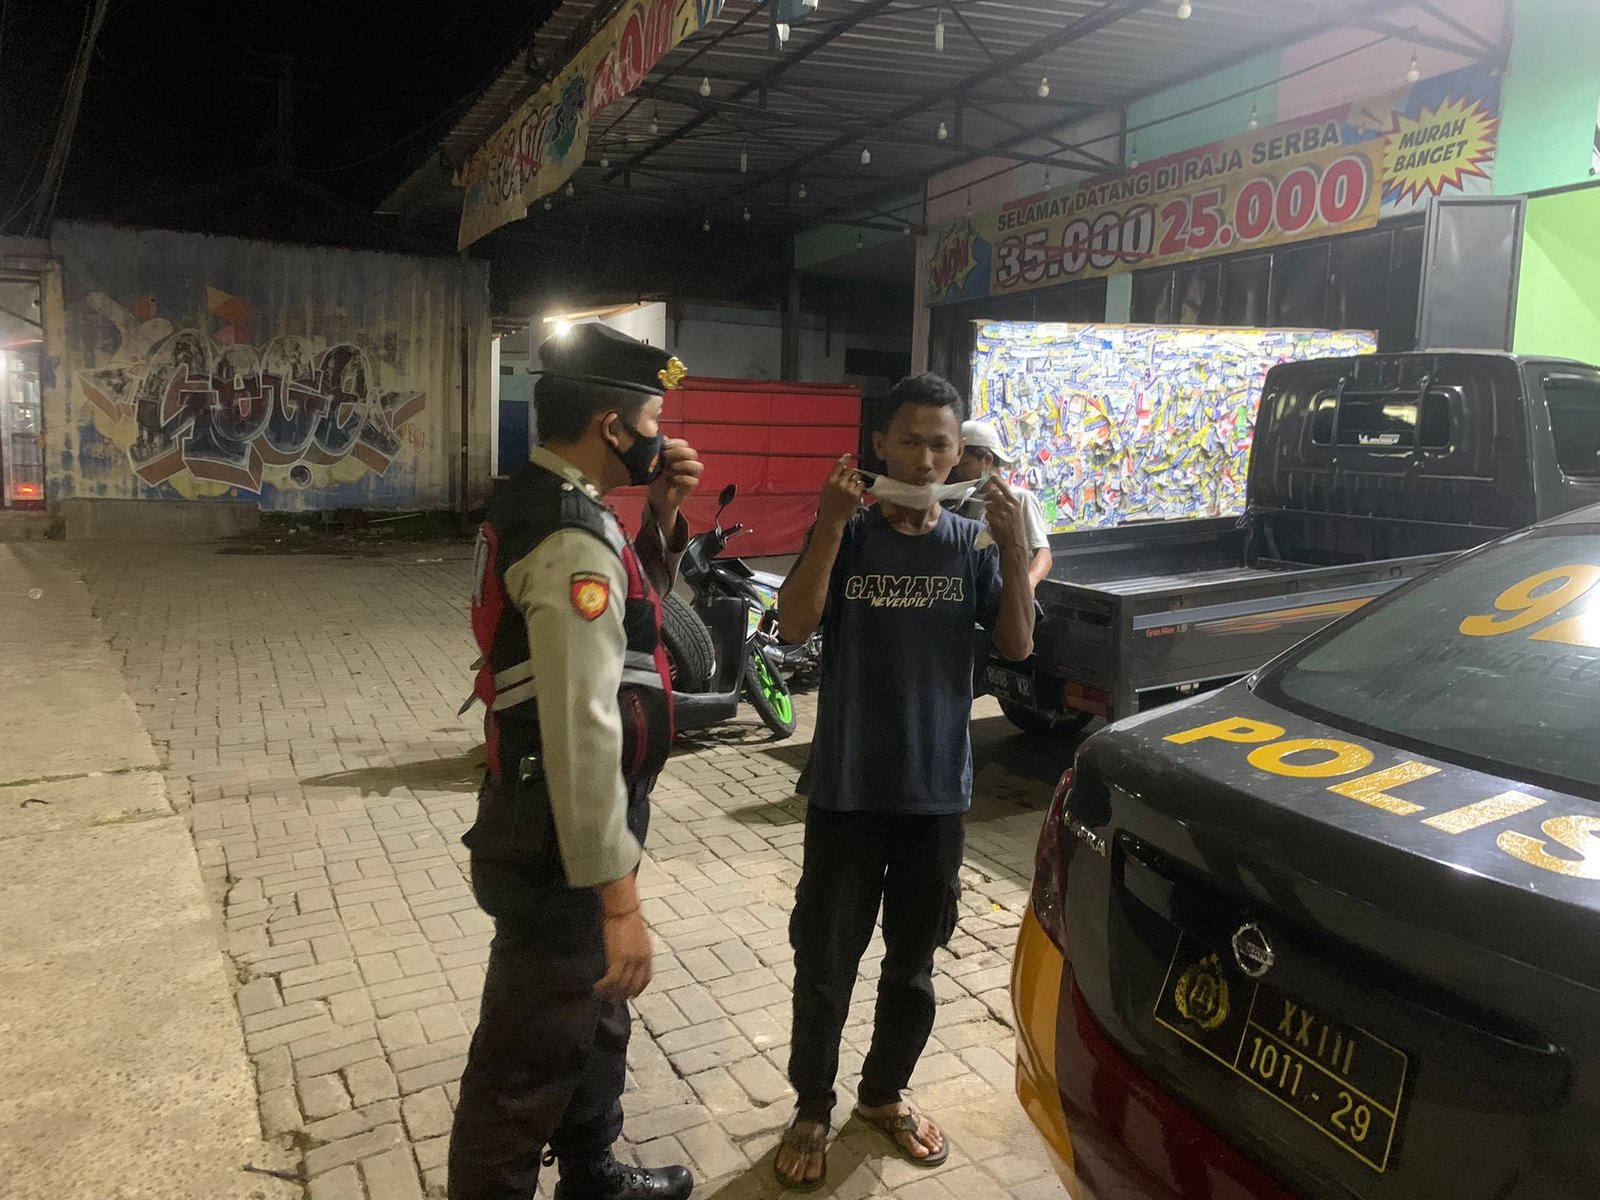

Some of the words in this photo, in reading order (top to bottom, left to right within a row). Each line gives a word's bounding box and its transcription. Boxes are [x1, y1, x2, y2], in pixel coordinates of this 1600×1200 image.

[997, 196, 1069, 231] SELAMAT
[1075, 174, 1149, 211] DATANG
[1156, 163, 1177, 190] DI
[1184, 149, 1243, 183] RAJA
[1252, 122, 1339, 165] SERBA
[1393, 139, 1469, 173] BANGET
[1398, 117, 1467, 151] MURAH
[997, 203, 1157, 288] 35.000
[1158, 154, 1368, 257] 25.000
[1162, 716, 1600, 880] POLIS
[1250, 1037, 1304, 1096] 1011
[1331, 1091, 1371, 1141] 29
